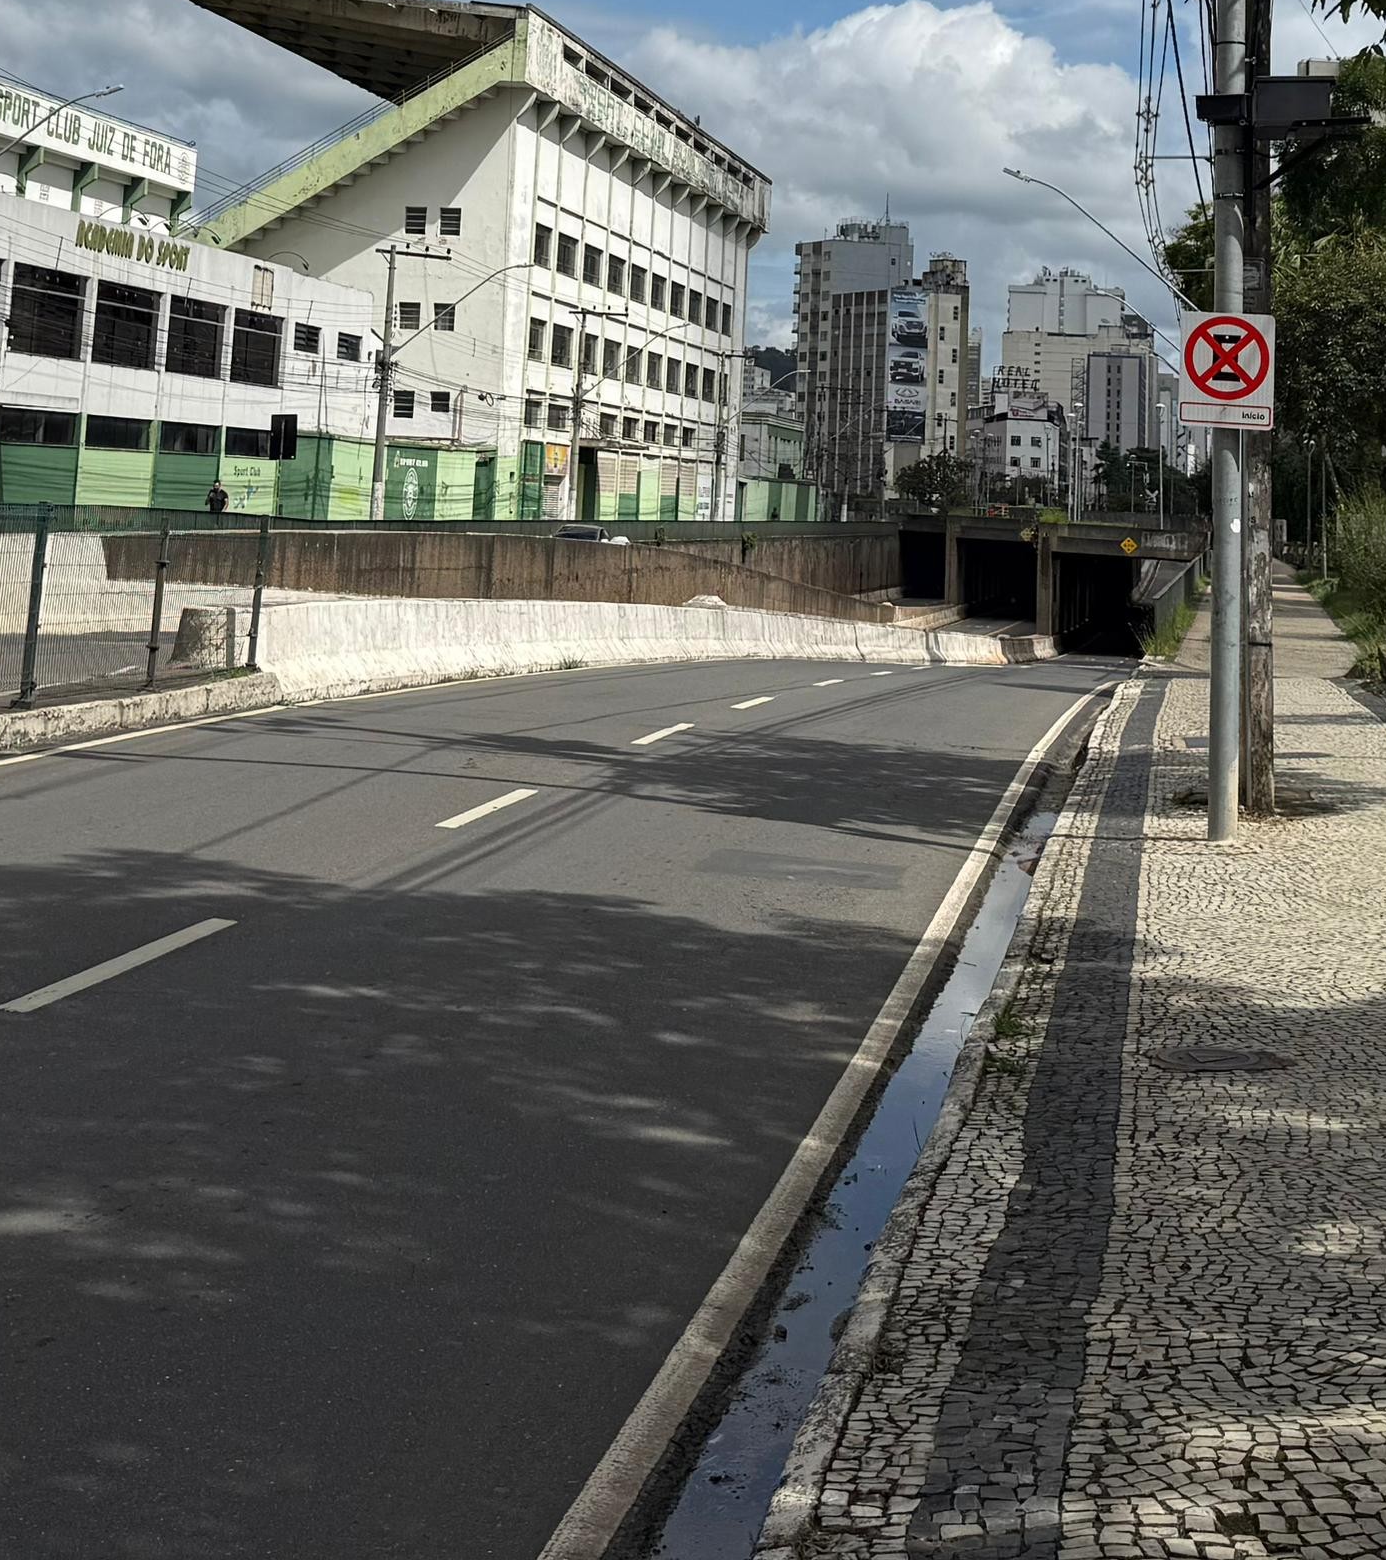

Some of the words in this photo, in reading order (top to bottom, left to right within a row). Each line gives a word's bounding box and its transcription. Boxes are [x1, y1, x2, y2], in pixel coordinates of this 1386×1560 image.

[47, 106, 81, 146] CLUB
[88, 121, 115, 156] JUIZ
[121, 132, 137, 163] DE
[142, 138, 171, 175] FORA
[75, 219, 134, 259] ACADEMIA
[136, 234, 154, 264] DO
[156, 240, 190, 272] SPORT
[996, 365, 1031, 377] REAL
